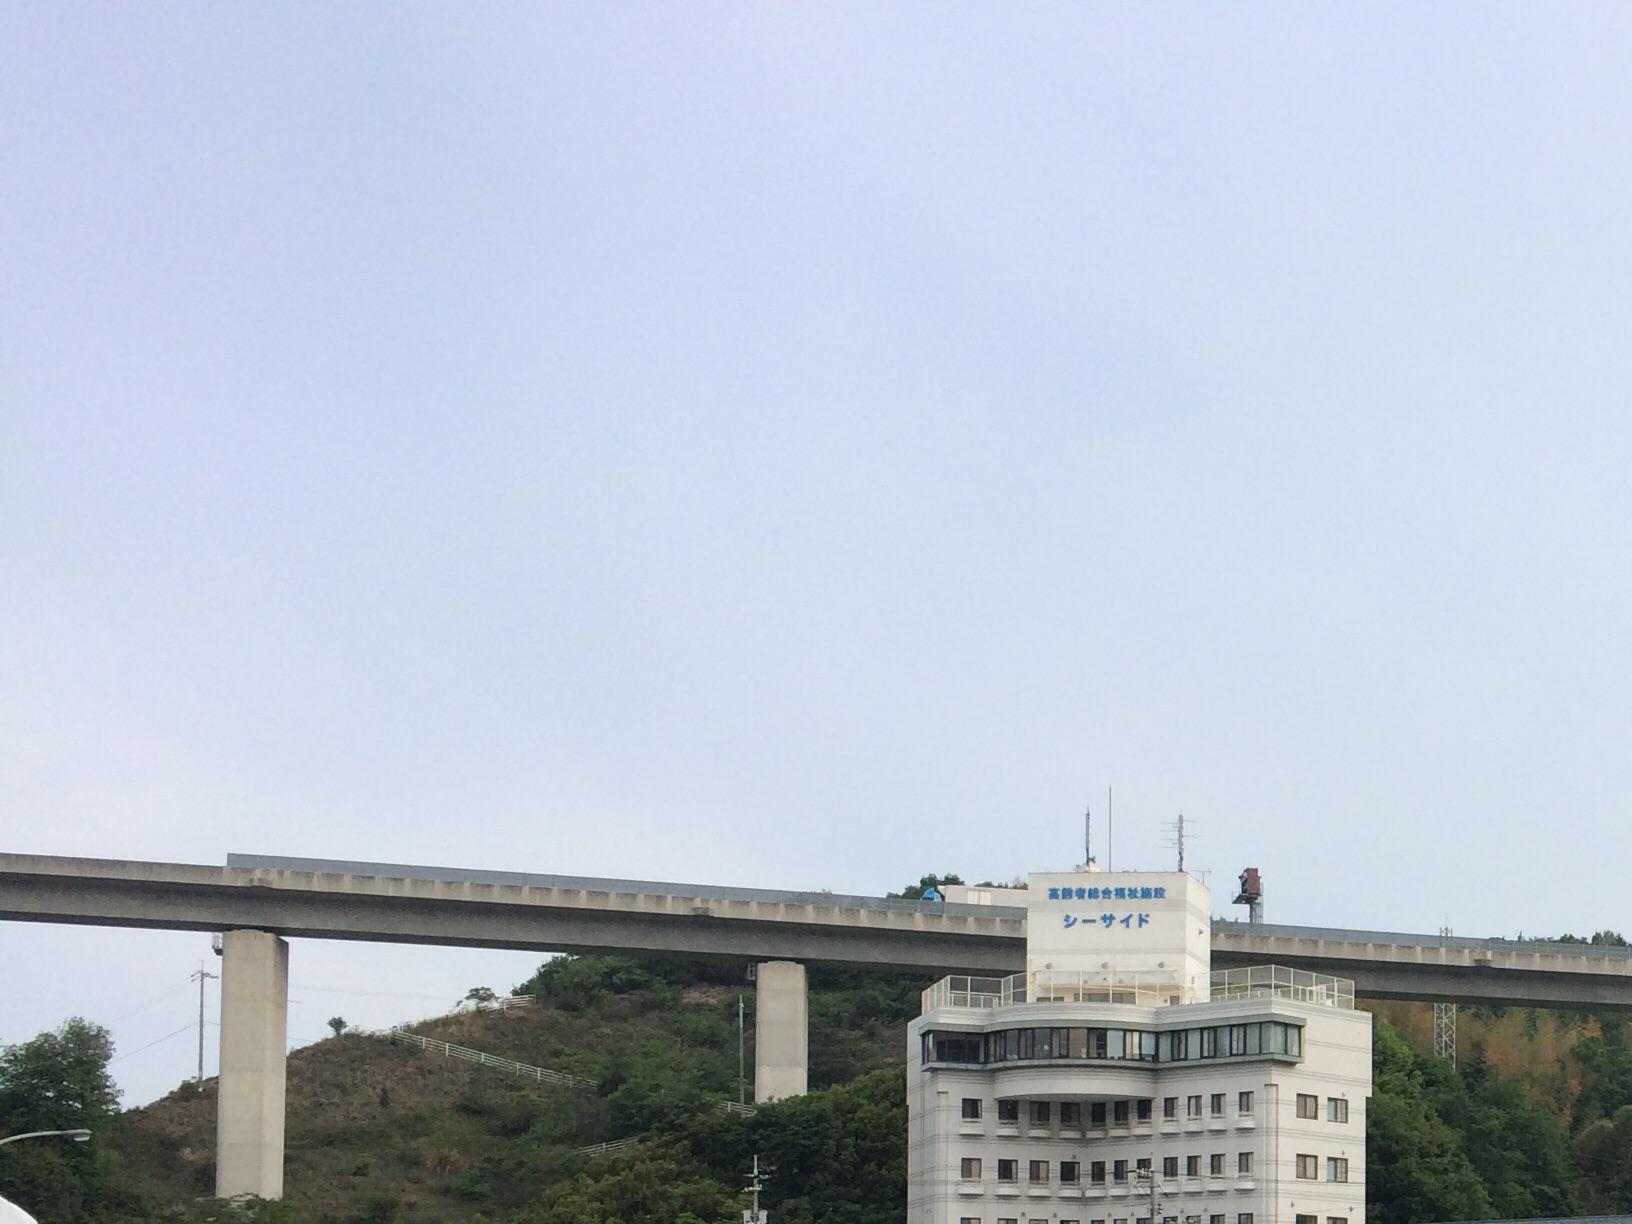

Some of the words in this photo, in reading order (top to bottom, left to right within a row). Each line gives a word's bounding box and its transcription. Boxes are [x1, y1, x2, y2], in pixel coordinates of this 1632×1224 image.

[1063, 913, 1150, 928] シーサイド
